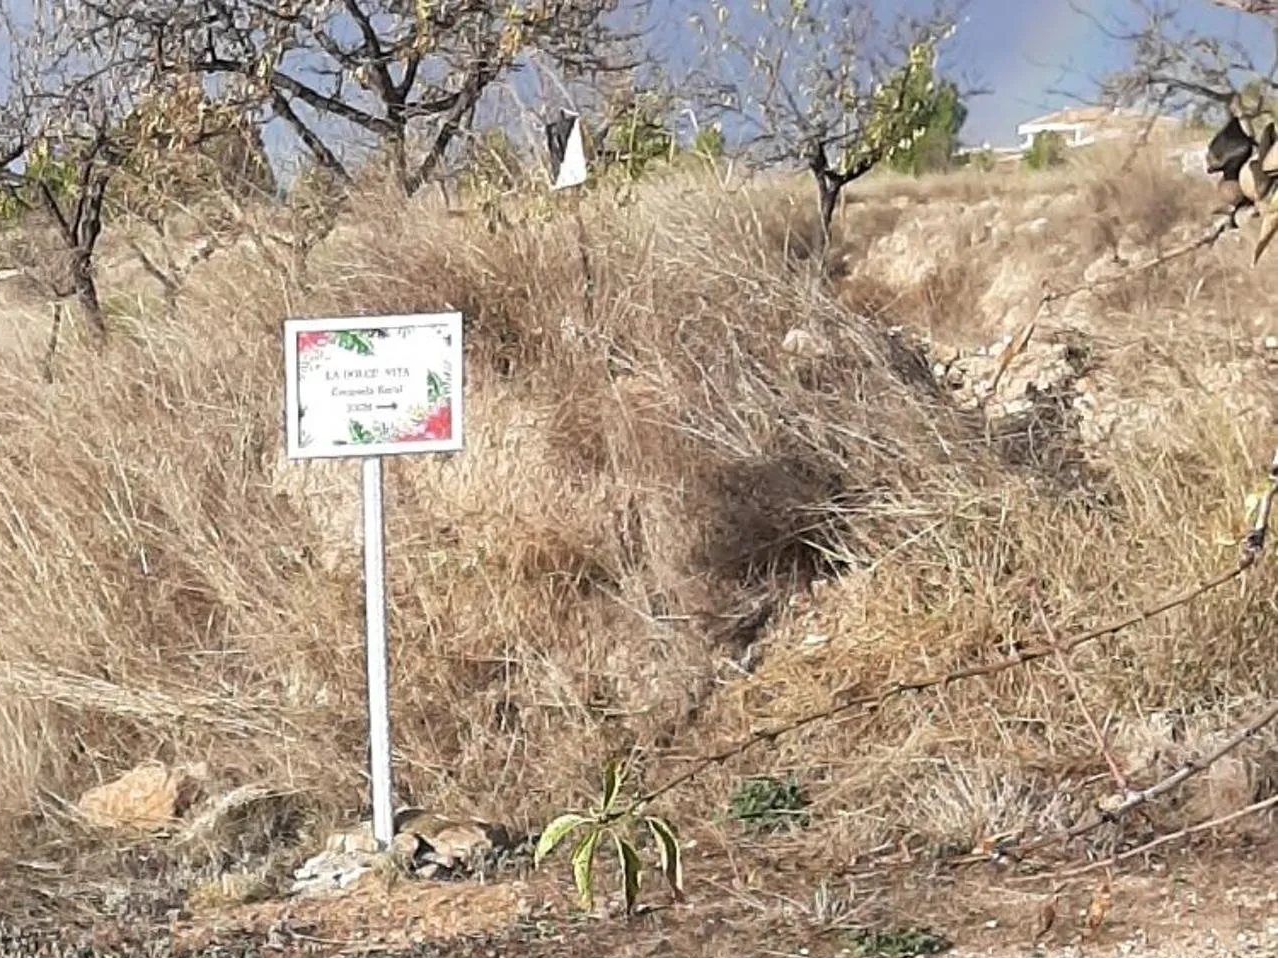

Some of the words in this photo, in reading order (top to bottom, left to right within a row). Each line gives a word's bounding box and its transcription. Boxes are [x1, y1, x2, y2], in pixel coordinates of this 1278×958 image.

[325, 369, 340, 381] LA
[343, 368, 378, 379] DOLCE
[385, 367, 410, 378] VITA
